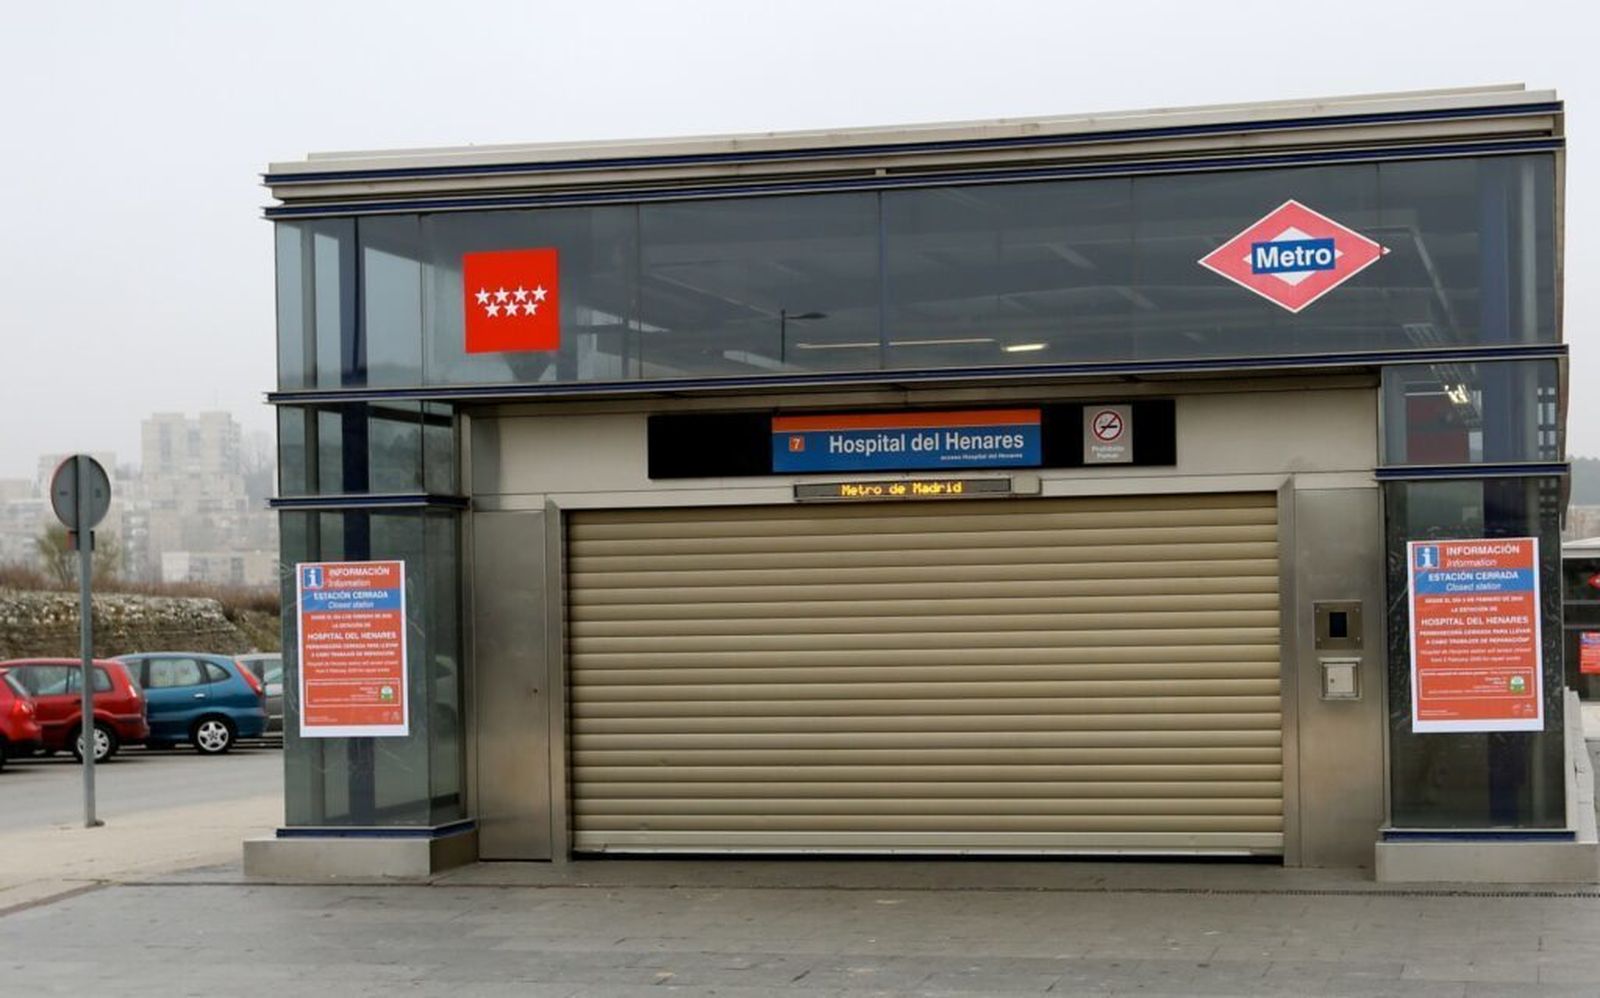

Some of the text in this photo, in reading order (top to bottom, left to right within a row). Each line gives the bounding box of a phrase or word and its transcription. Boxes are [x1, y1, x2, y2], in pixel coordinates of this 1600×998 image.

[1257, 246, 1332, 268] Metro
[792, 438, 801, 450] 7
[829, 432, 1024, 456] Hospital del Henares
[841, 481, 962, 496] Metro de Madrid
[1446, 544, 1520, 556] INFORMACIÓN
[329, 566, 390, 576] INFORMACIÓN
[1428, 570, 1519, 582] ESTACIÓN CERRADA
[314, 591, 351, 600] ESTACIÓN
[1421, 615, 1528, 626] HOSPITAL DEL HENARES
[307, 630, 397, 640] HOSPITAL DEL HENARES
